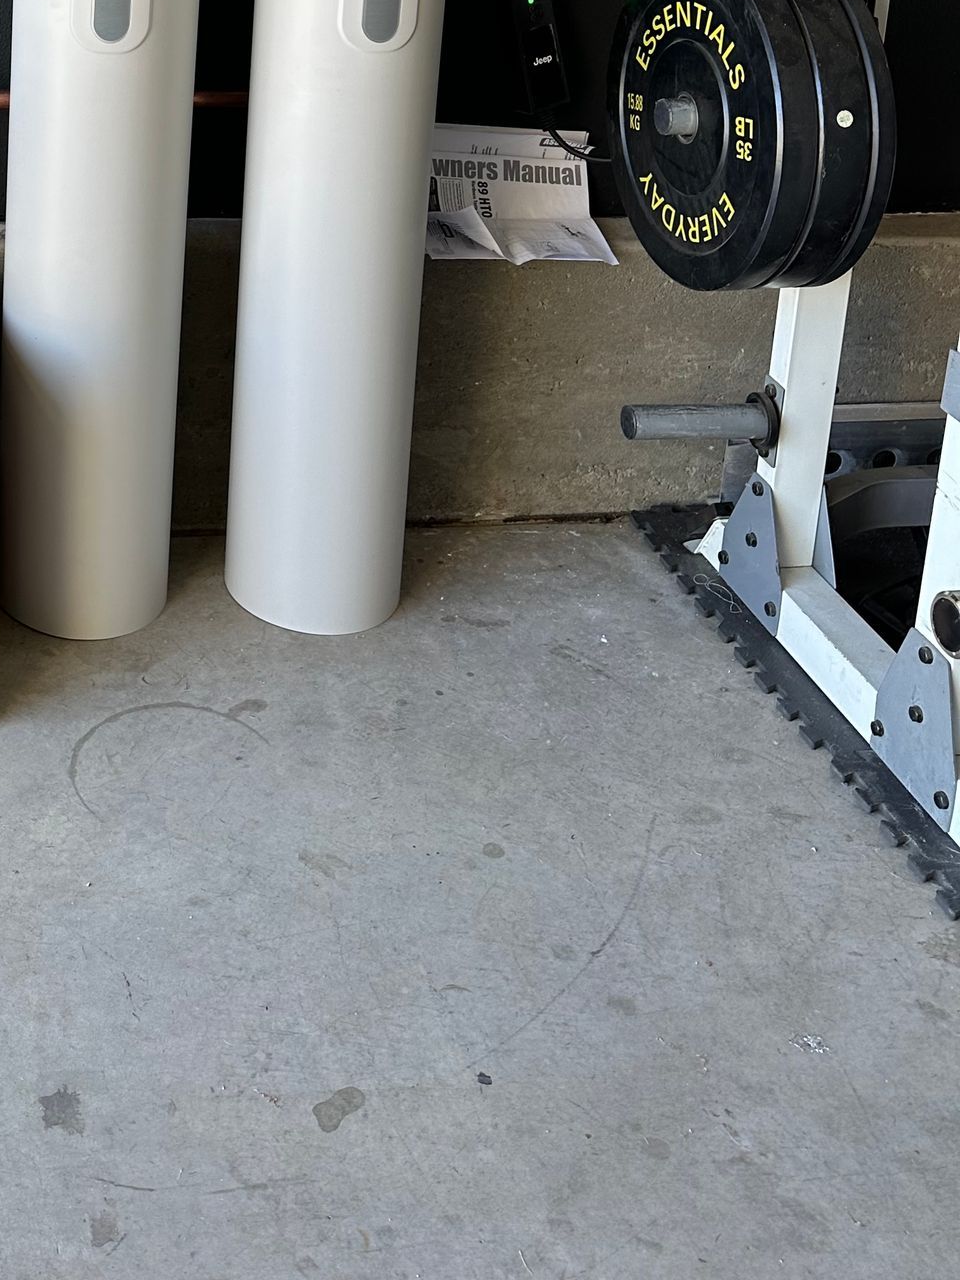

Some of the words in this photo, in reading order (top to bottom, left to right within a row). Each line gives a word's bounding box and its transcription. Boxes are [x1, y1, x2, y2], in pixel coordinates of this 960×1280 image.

[635, 1, 746, 91] ESSENTIALS
[533, 55, 553, 66] Jeep
[627, 92, 644, 111] 15.88
[629, 114, 640, 131] KG
[735, 116, 754, 139] LB
[735, 140, 753, 161] 35
[431, 158, 499, 181] wners
[503, 159, 582, 186] Manual
[477, 181, 489, 195] 89
[639, 173, 736, 243] EVERYDAY
